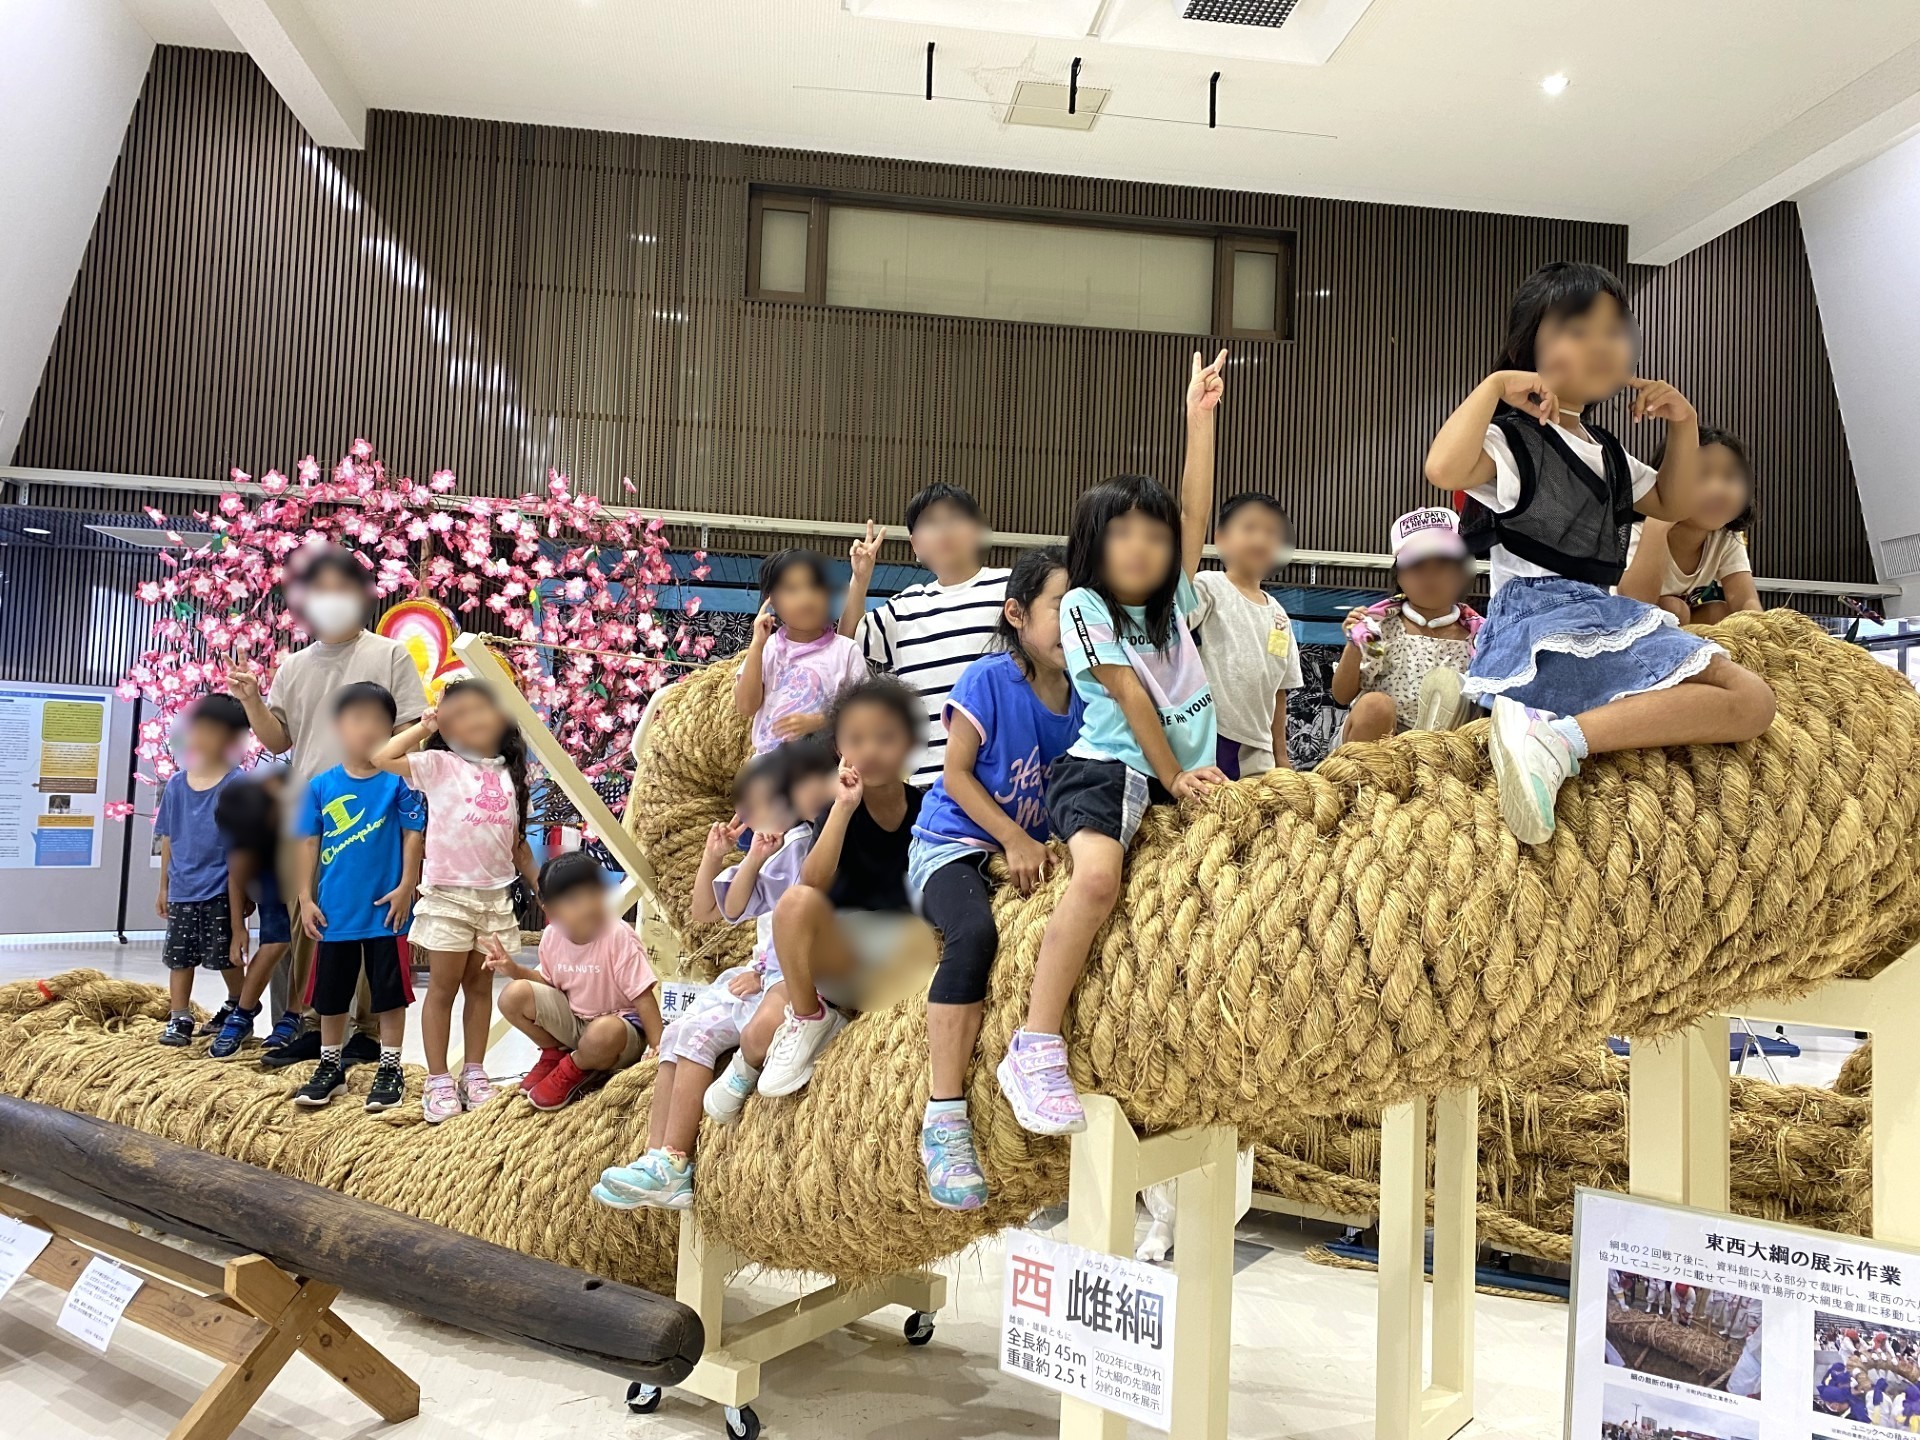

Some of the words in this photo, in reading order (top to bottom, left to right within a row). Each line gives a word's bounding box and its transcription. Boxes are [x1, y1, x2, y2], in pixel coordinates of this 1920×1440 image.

[1411, 519, 1429, 528] NEW
[1185, 693, 1213, 717] YOUR
[461, 812, 482, 827] My
[557, 963, 600, 974] PEANUTS
[662, 990, 678, 1012] 東
[1704, 1232, 1902, 1287] 東西大綱の展示作業
[1012, 1254, 1055, 1318] 西
[1066, 1269, 1164, 1350] 雌綱
[1007, 1327, 1051, 1358] 全長約
[1054, 1343, 1087, 1367] 45m
[1007, 1348, 1050, 1378] 重量約
